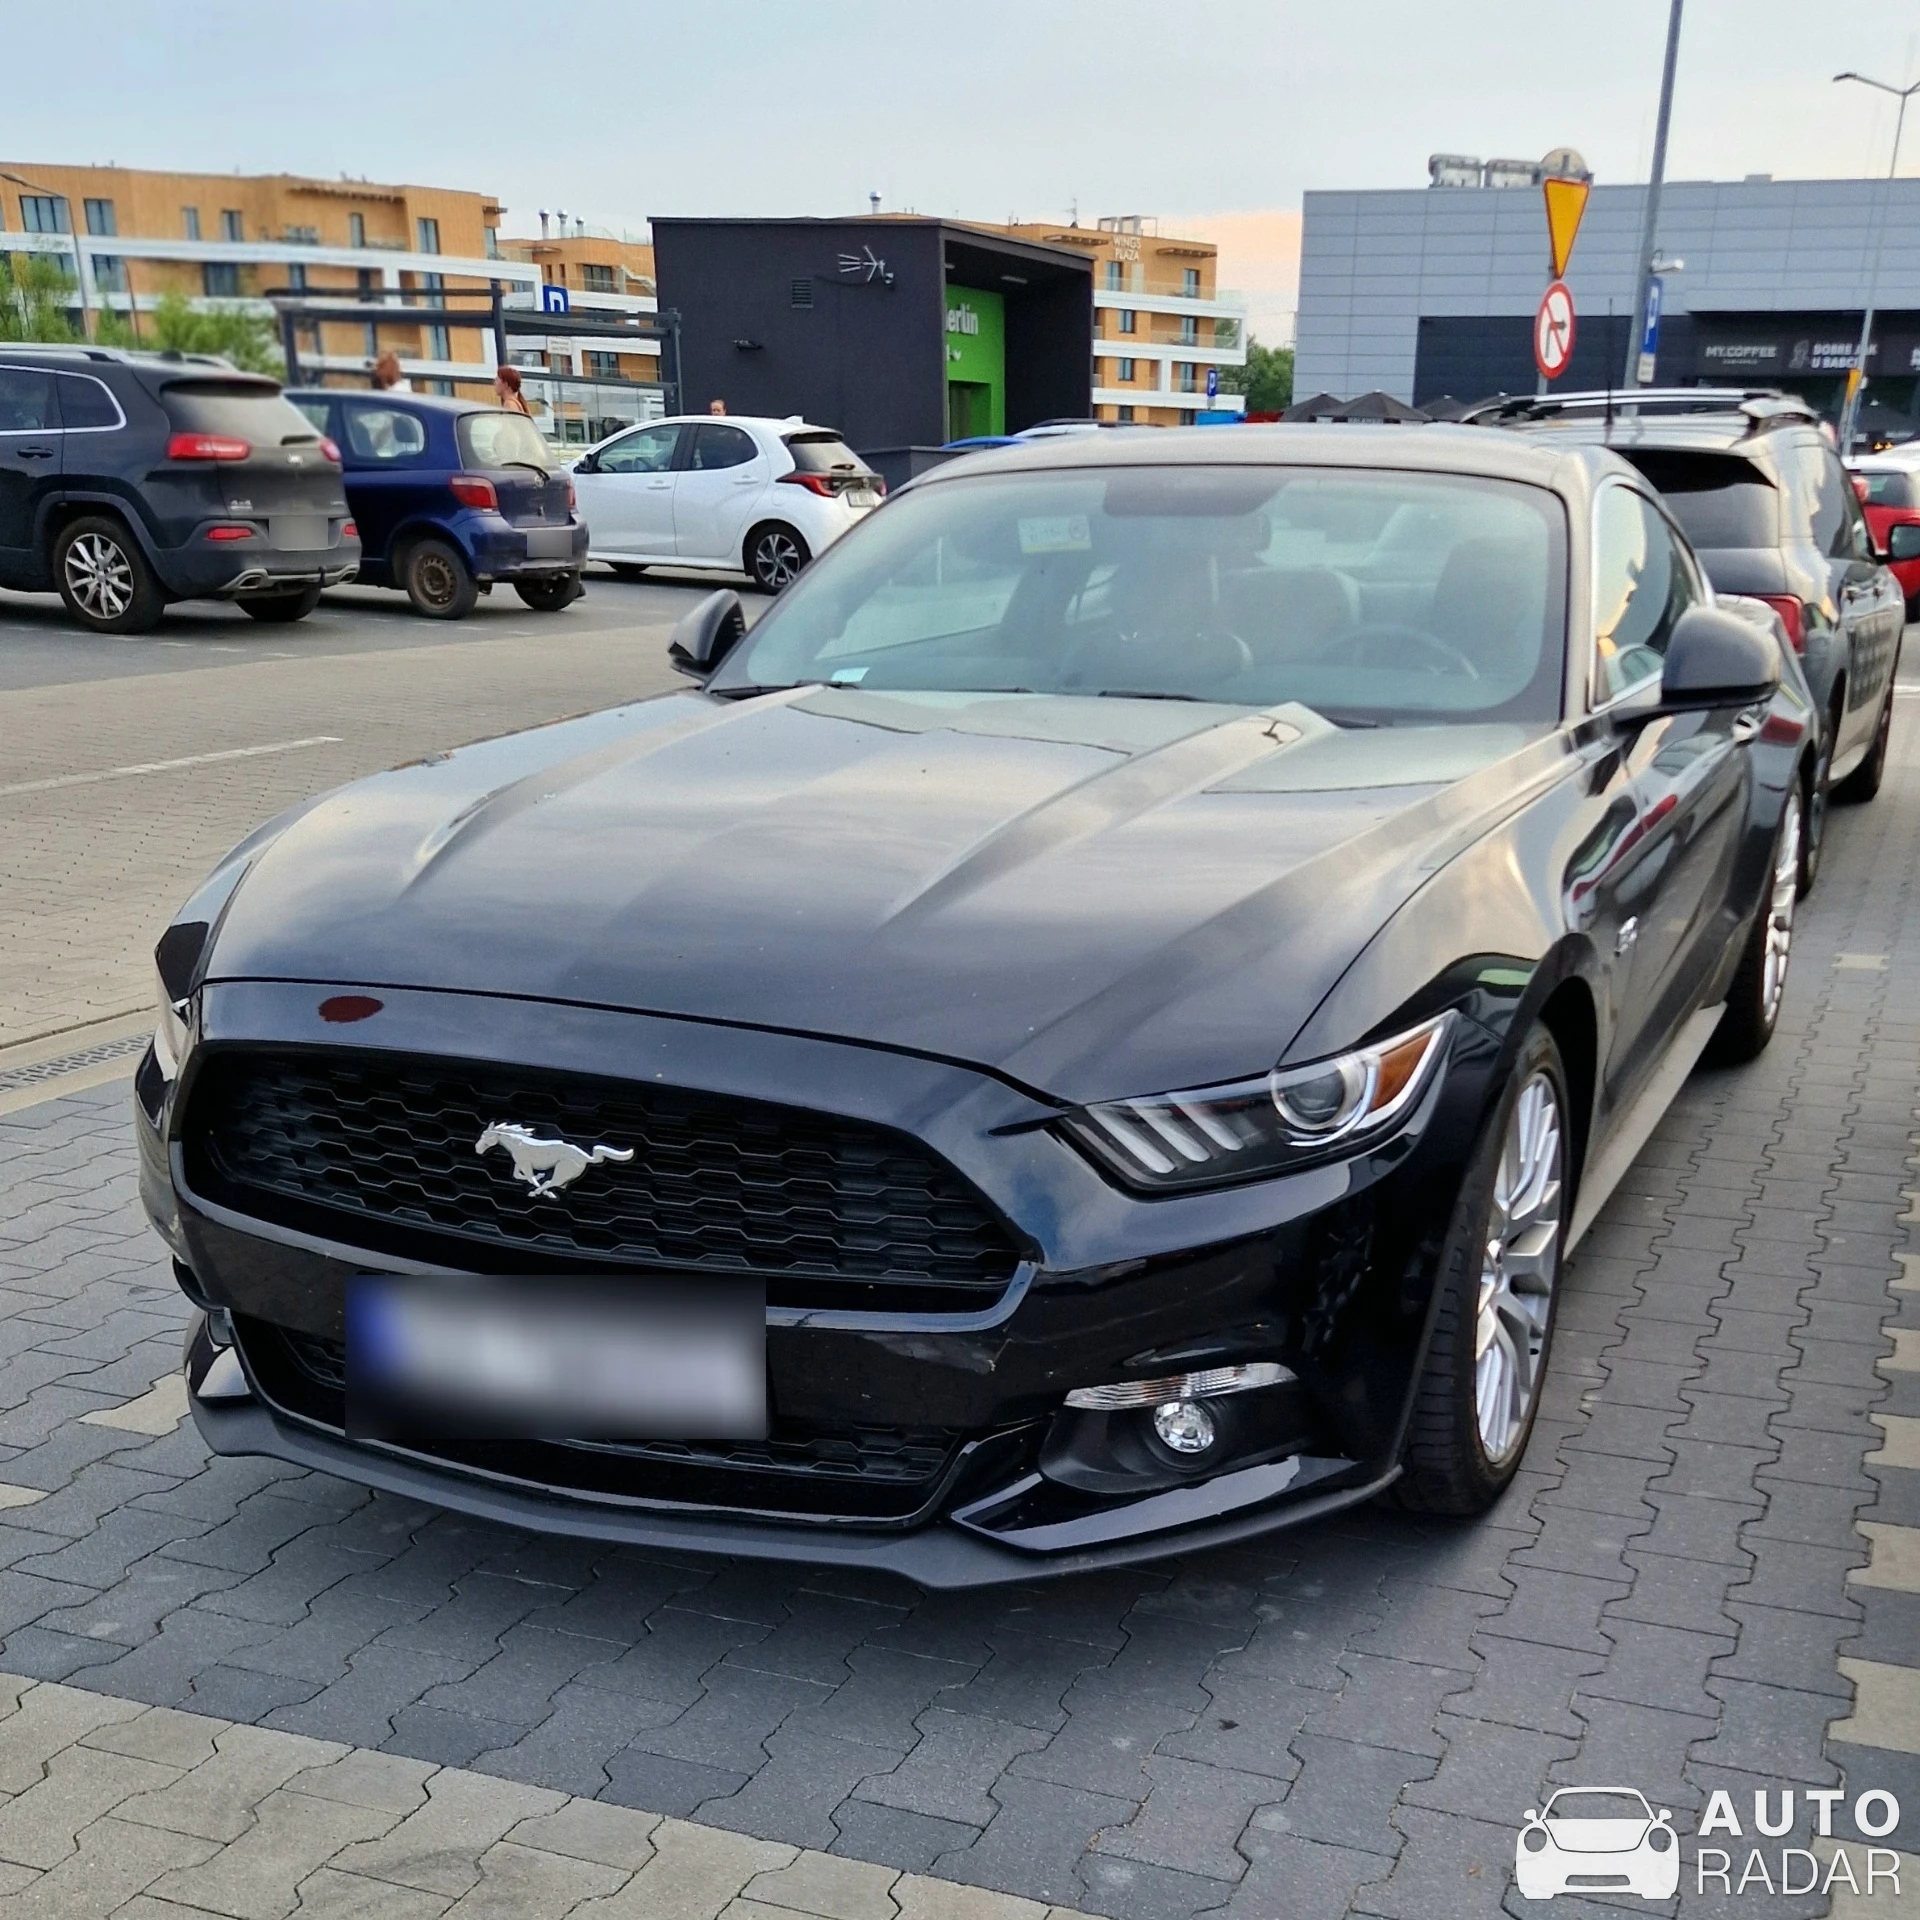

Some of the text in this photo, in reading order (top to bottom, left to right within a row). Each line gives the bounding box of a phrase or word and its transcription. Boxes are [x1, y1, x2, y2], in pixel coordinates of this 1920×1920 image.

[1112, 234, 1141, 249] WINGS
[1115, 248, 1140, 261] PLAZA
[945, 303, 979, 335] erlin
